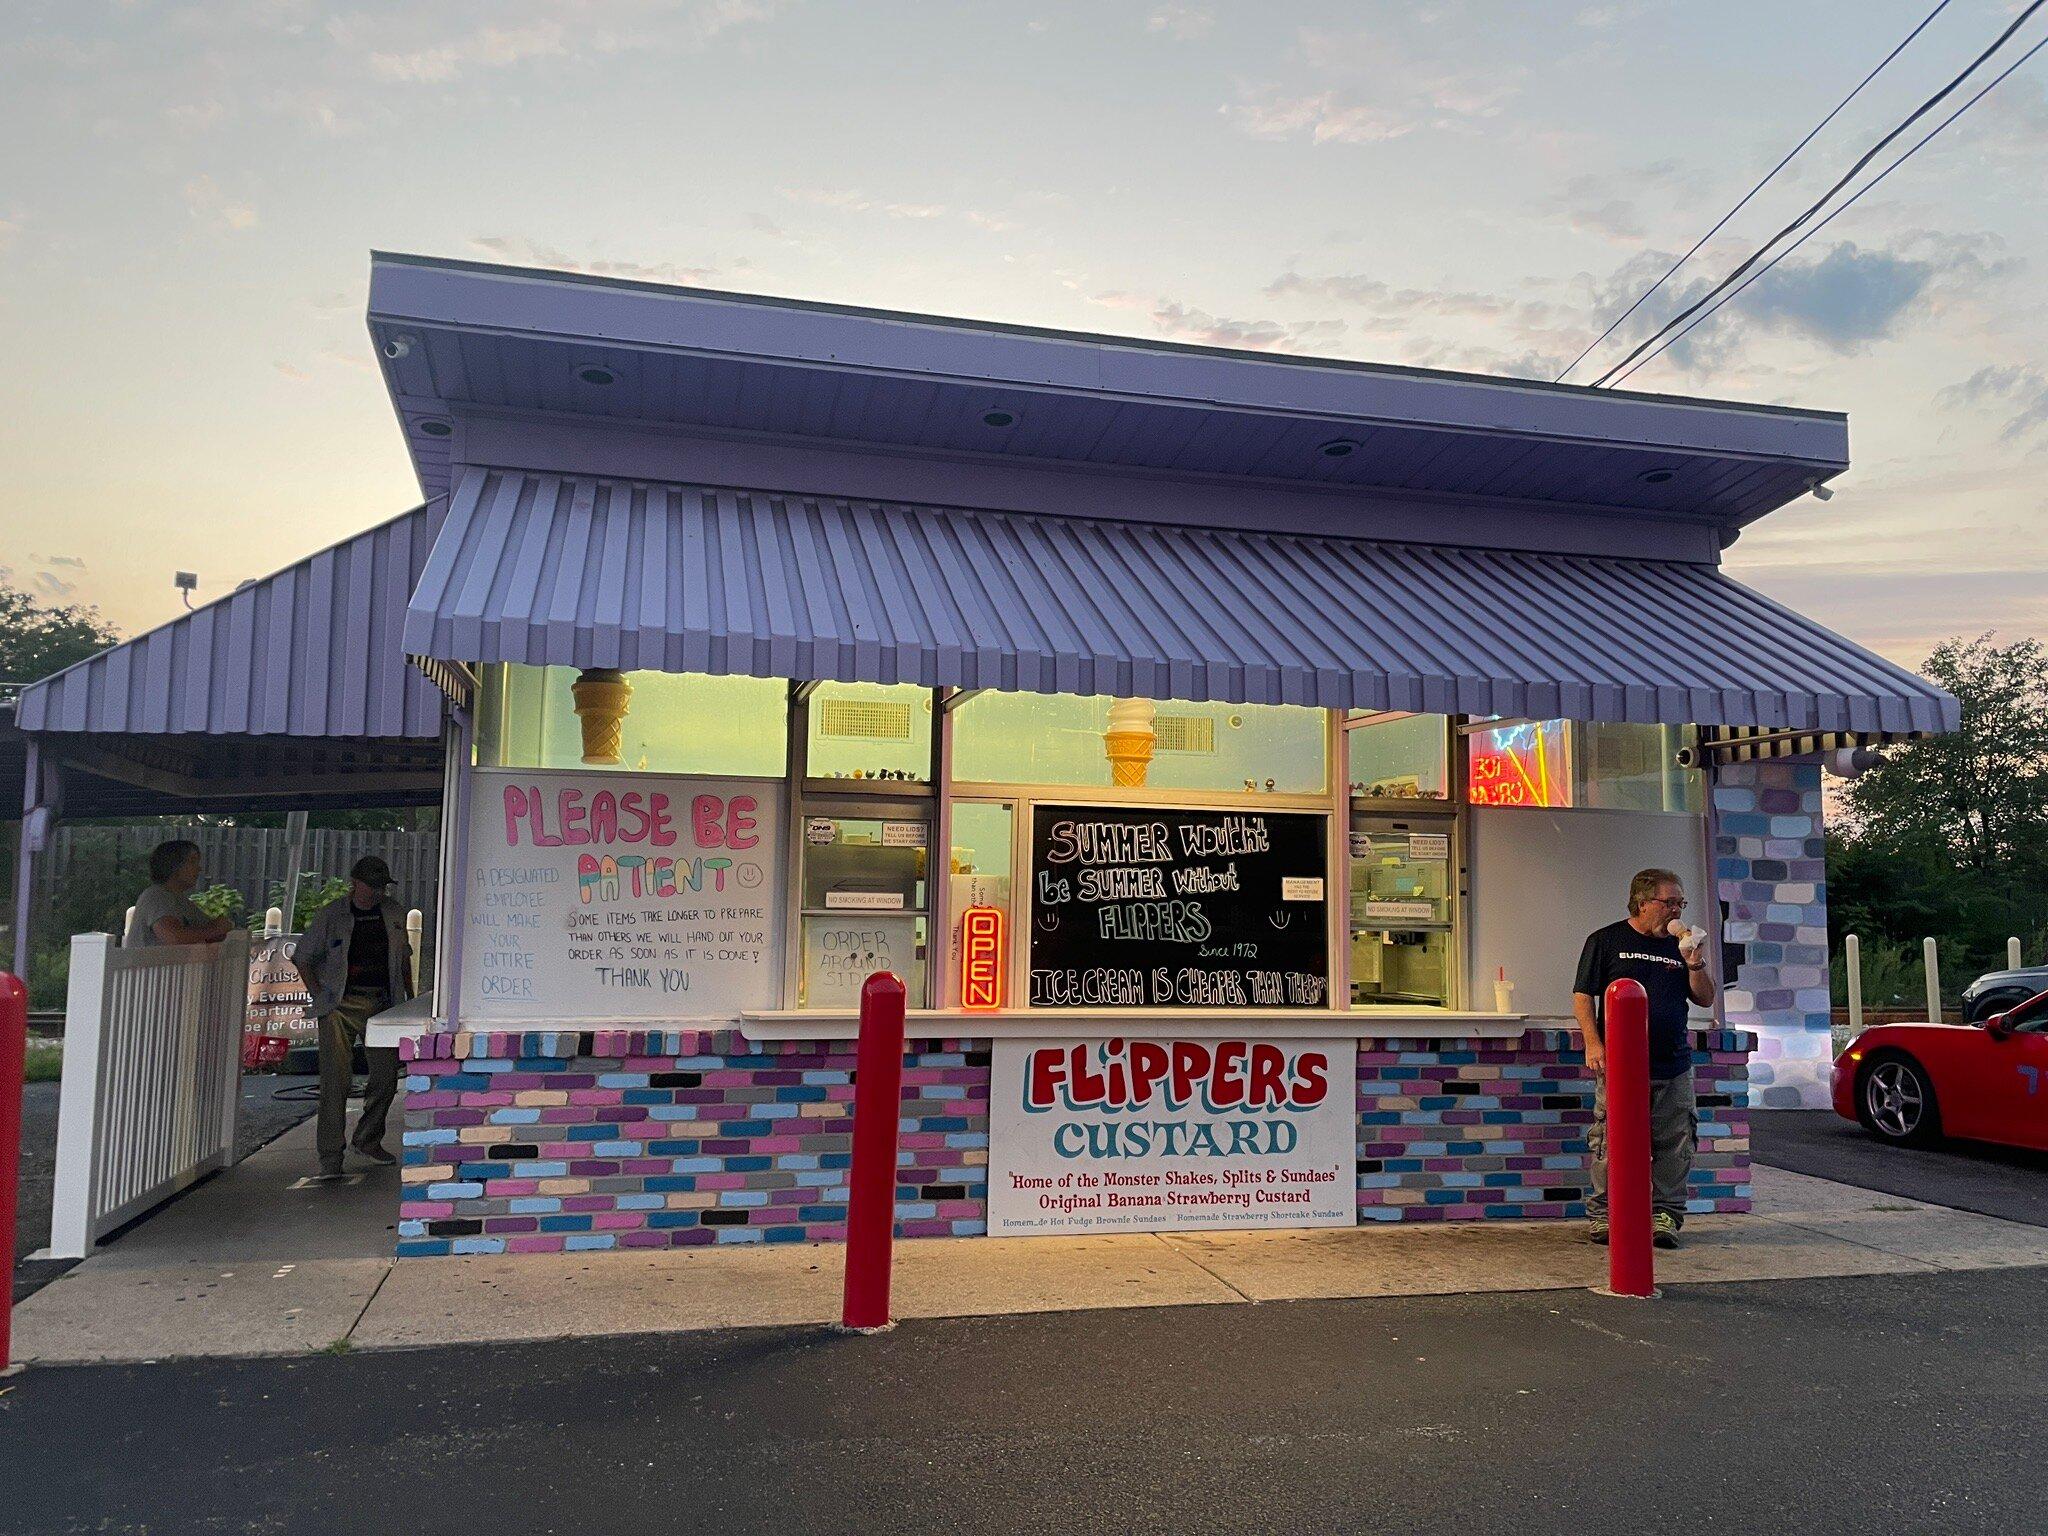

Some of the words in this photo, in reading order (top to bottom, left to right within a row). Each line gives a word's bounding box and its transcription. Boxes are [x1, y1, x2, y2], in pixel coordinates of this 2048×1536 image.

[504, 785, 677, 847] PLEASE
[692, 794, 759, 849] BE
[1047, 821, 1173, 865] SUMMER
[477, 868, 486, 887] A
[578, 854, 732, 904] PATIENT
[1039, 870, 1071, 905] be
[1077, 867, 1167, 901] SUMMER
[507, 914, 541, 928] MAKE
[568, 911, 599, 927] SOME
[607, 912, 637, 925] ITEMS
[641, 911, 663, 922] TAKE
[667, 910, 700, 922] LONGER
[704, 910, 715, 919] TO
[721, 908, 764, 919] PREPARE
[1099, 900, 1211, 942] FLIPPERS
[489, 934, 520, 948] YOUR
[568, 933, 593, 942] THAN
[597, 931, 632, 943] OTHERS
[637, 933, 651, 942] WE
[658, 933, 682, 944] WILL
[687, 931, 714, 943] HAND
[719, 931, 734, 942] OUT
[739, 932, 764, 944] YOUR
[823, 931, 890, 953] ORDER
[568, 949, 602, 960] ORDER
[609, 948, 624, 960] AS
[630, 948, 656, 959] SOON
[664, 949, 678, 959] AS
[686, 949, 696, 959] IT
[704, 950, 714, 960] IS
[971, 916, 995, 1004] OPEN
[1233, 943, 1257, 958] 1972
[1619, 952, 1683, 967] EUROSPORT
[484, 952, 534, 969] ENTIRE
[821, 954, 891, 970] AROUND
[482, 976, 532, 997] ORDER
[595, 967, 651, 987] THANK
[660, 968, 690, 993] YOU
[1031, 969, 1082, 1005] ICE
[1083, 967, 1144, 1004] CREAM
[1152, 967, 1173, 1004] IS
[1177, 968, 1247, 1005] CHEAPER
[1246, 970, 1284, 1004] THAN
[246, 1006, 303, 1018] parture
[266, 1021, 286, 1031] for
[1053, 1120, 1298, 1161] CUSTARD
[1058, 1173, 1073, 1188] of
[1077, 1173, 1098, 1187] the
[1104, 1172, 1160, 1186] Monster
[1165, 1170, 1218, 1186] Shakes,
[1222, 1169, 1262, 1188] Splits
[1266, 1169, 1276, 1183] &
[1039, 1193, 1101, 1213] Original
[1107, 1193, 1162, 1207] Banana
[1167, 1190, 1250, 1207] Strawberry
[1256, 1189, 1310, 1203] Custard
[1050, 1217, 1064, 1226] Hot
[1068, 1217, 1093, 1227] Fudge
[1096, 1215, 1131, 1225] Brownie
[1133, 1214, 1167, 1223] Sundaes
[1177, 1213, 1219, 1221] Homemade
[1222, 1212, 1268, 1221] Strawberry
[1270, 1210, 1310, 1219] Shortcake
[1312, 1210, 1344, 1218] Sundaes
